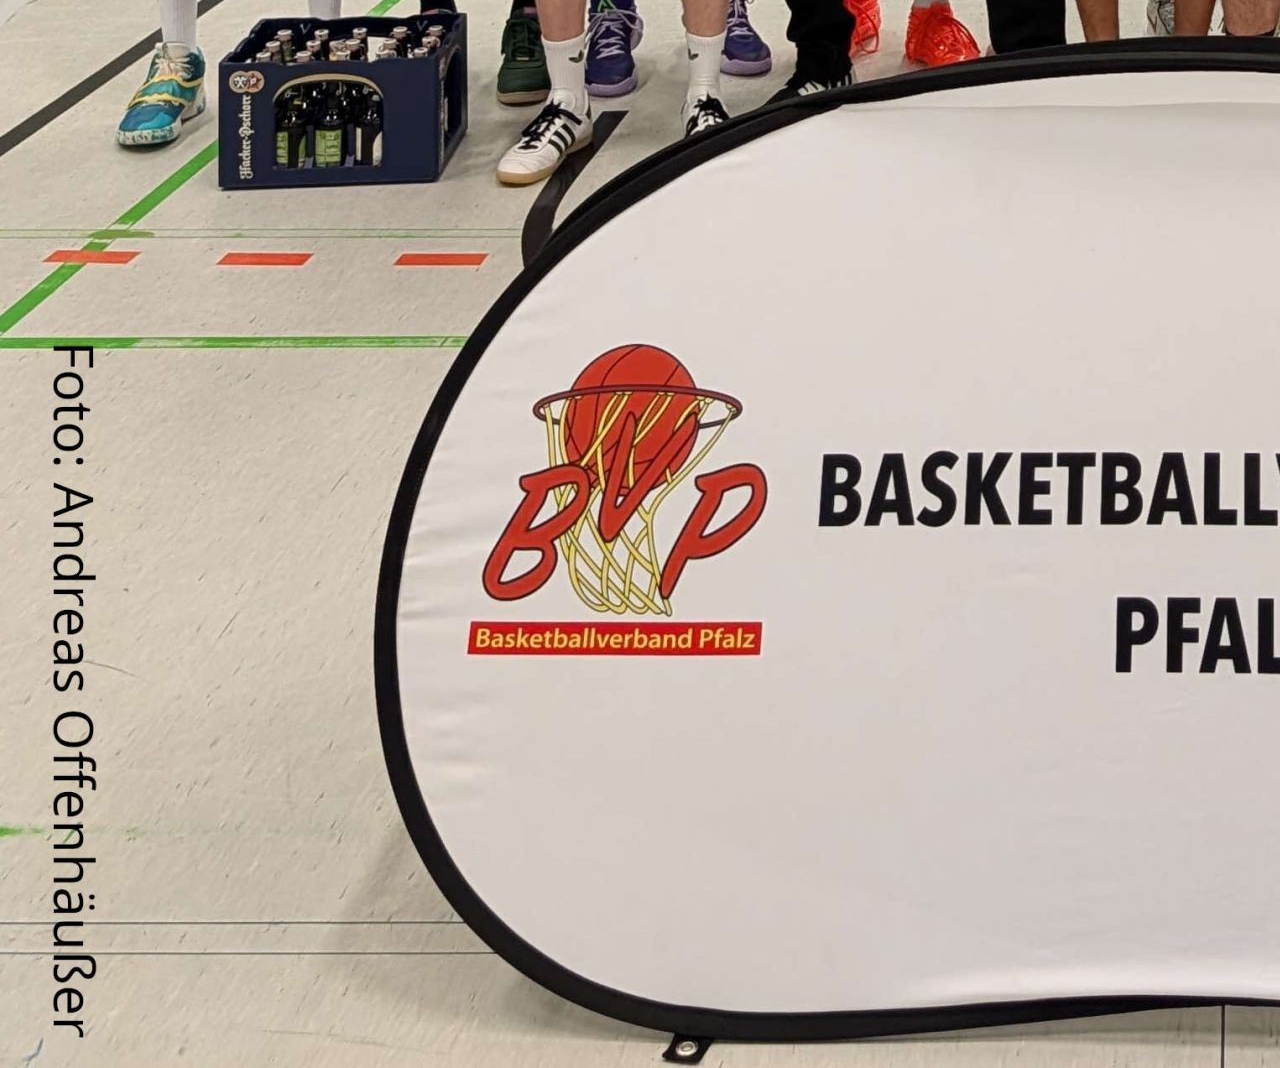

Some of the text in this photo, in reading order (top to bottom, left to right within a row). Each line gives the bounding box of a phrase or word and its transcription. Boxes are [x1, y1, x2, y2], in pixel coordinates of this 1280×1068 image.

[482, 411, 768, 602] BVP
[475, 627, 755, 650] Basketballverband Pfalz
